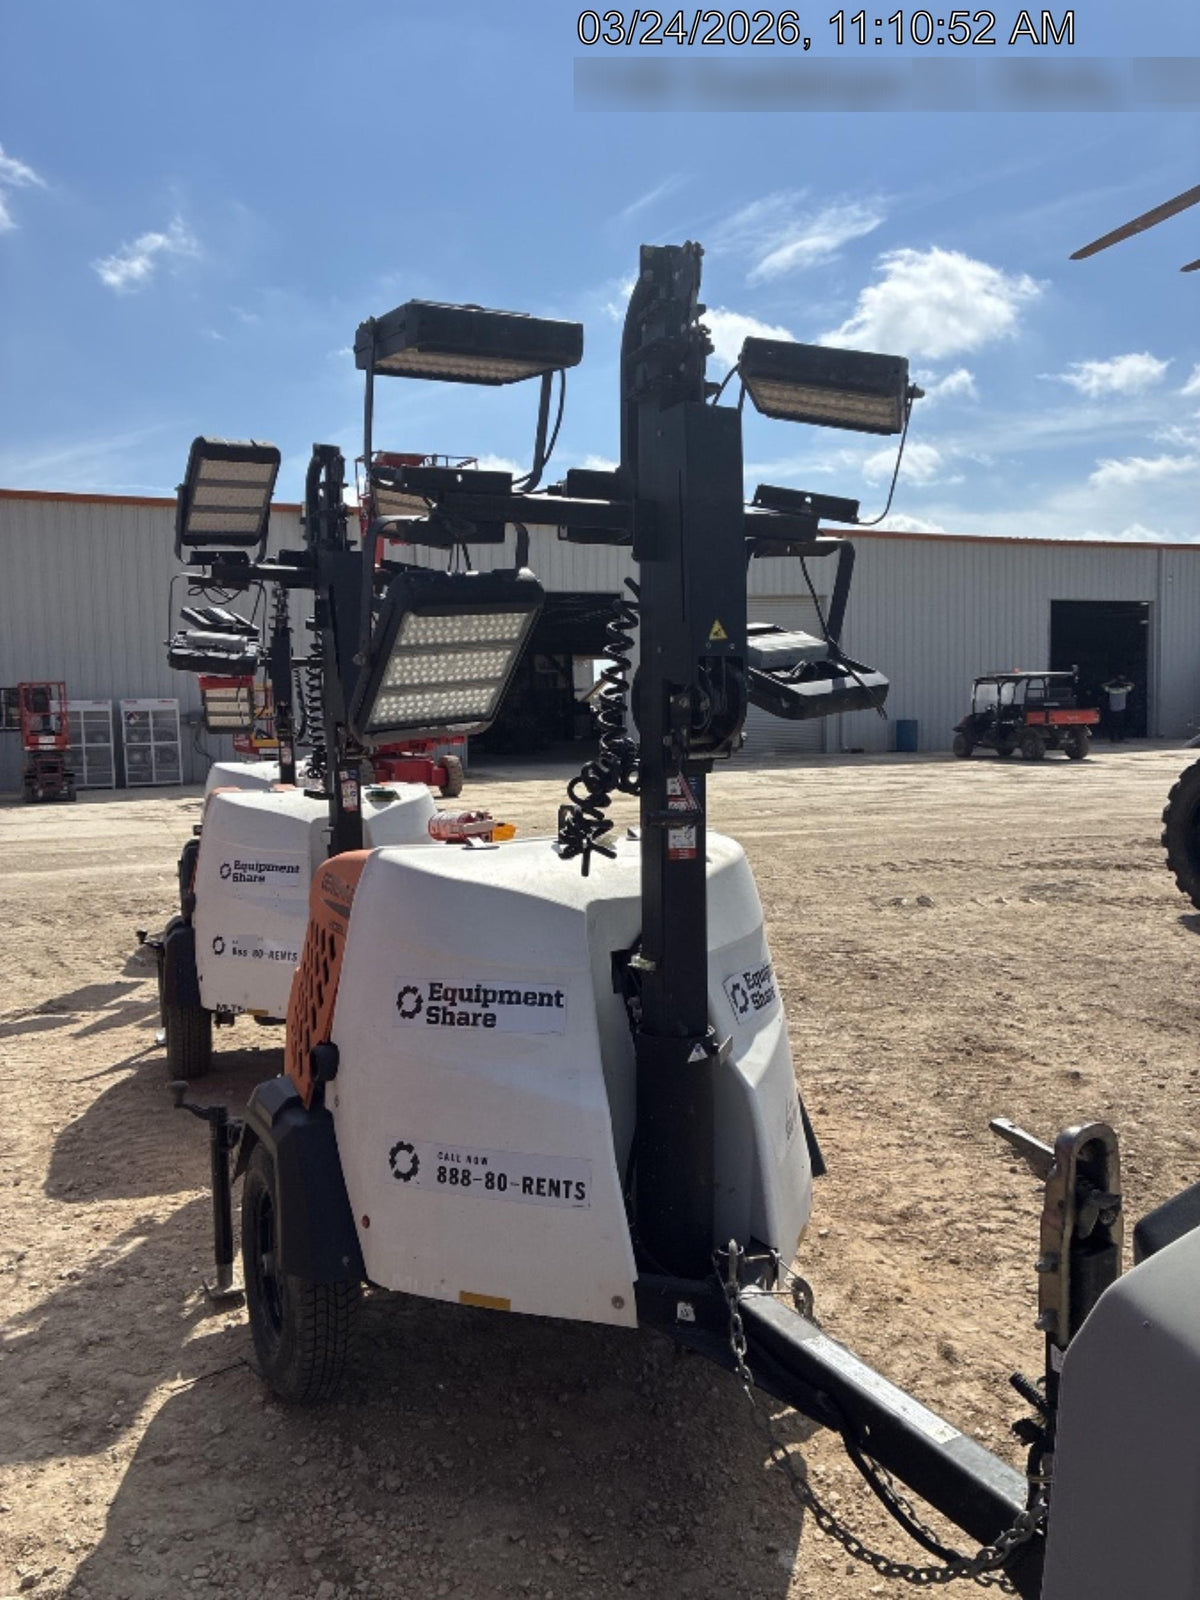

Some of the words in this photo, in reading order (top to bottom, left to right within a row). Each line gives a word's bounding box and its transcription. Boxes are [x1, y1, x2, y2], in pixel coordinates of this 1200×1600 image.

[233, 860, 300, 874] Equipment
[428, 982, 565, 1008] Equipment
[426, 1006, 497, 1028] Share
[437, 1151, 462, 1164] CALL
[466, 1154, 489, 1166] NOW
[436, 1165, 586, 1200] 888-80-RENTS
